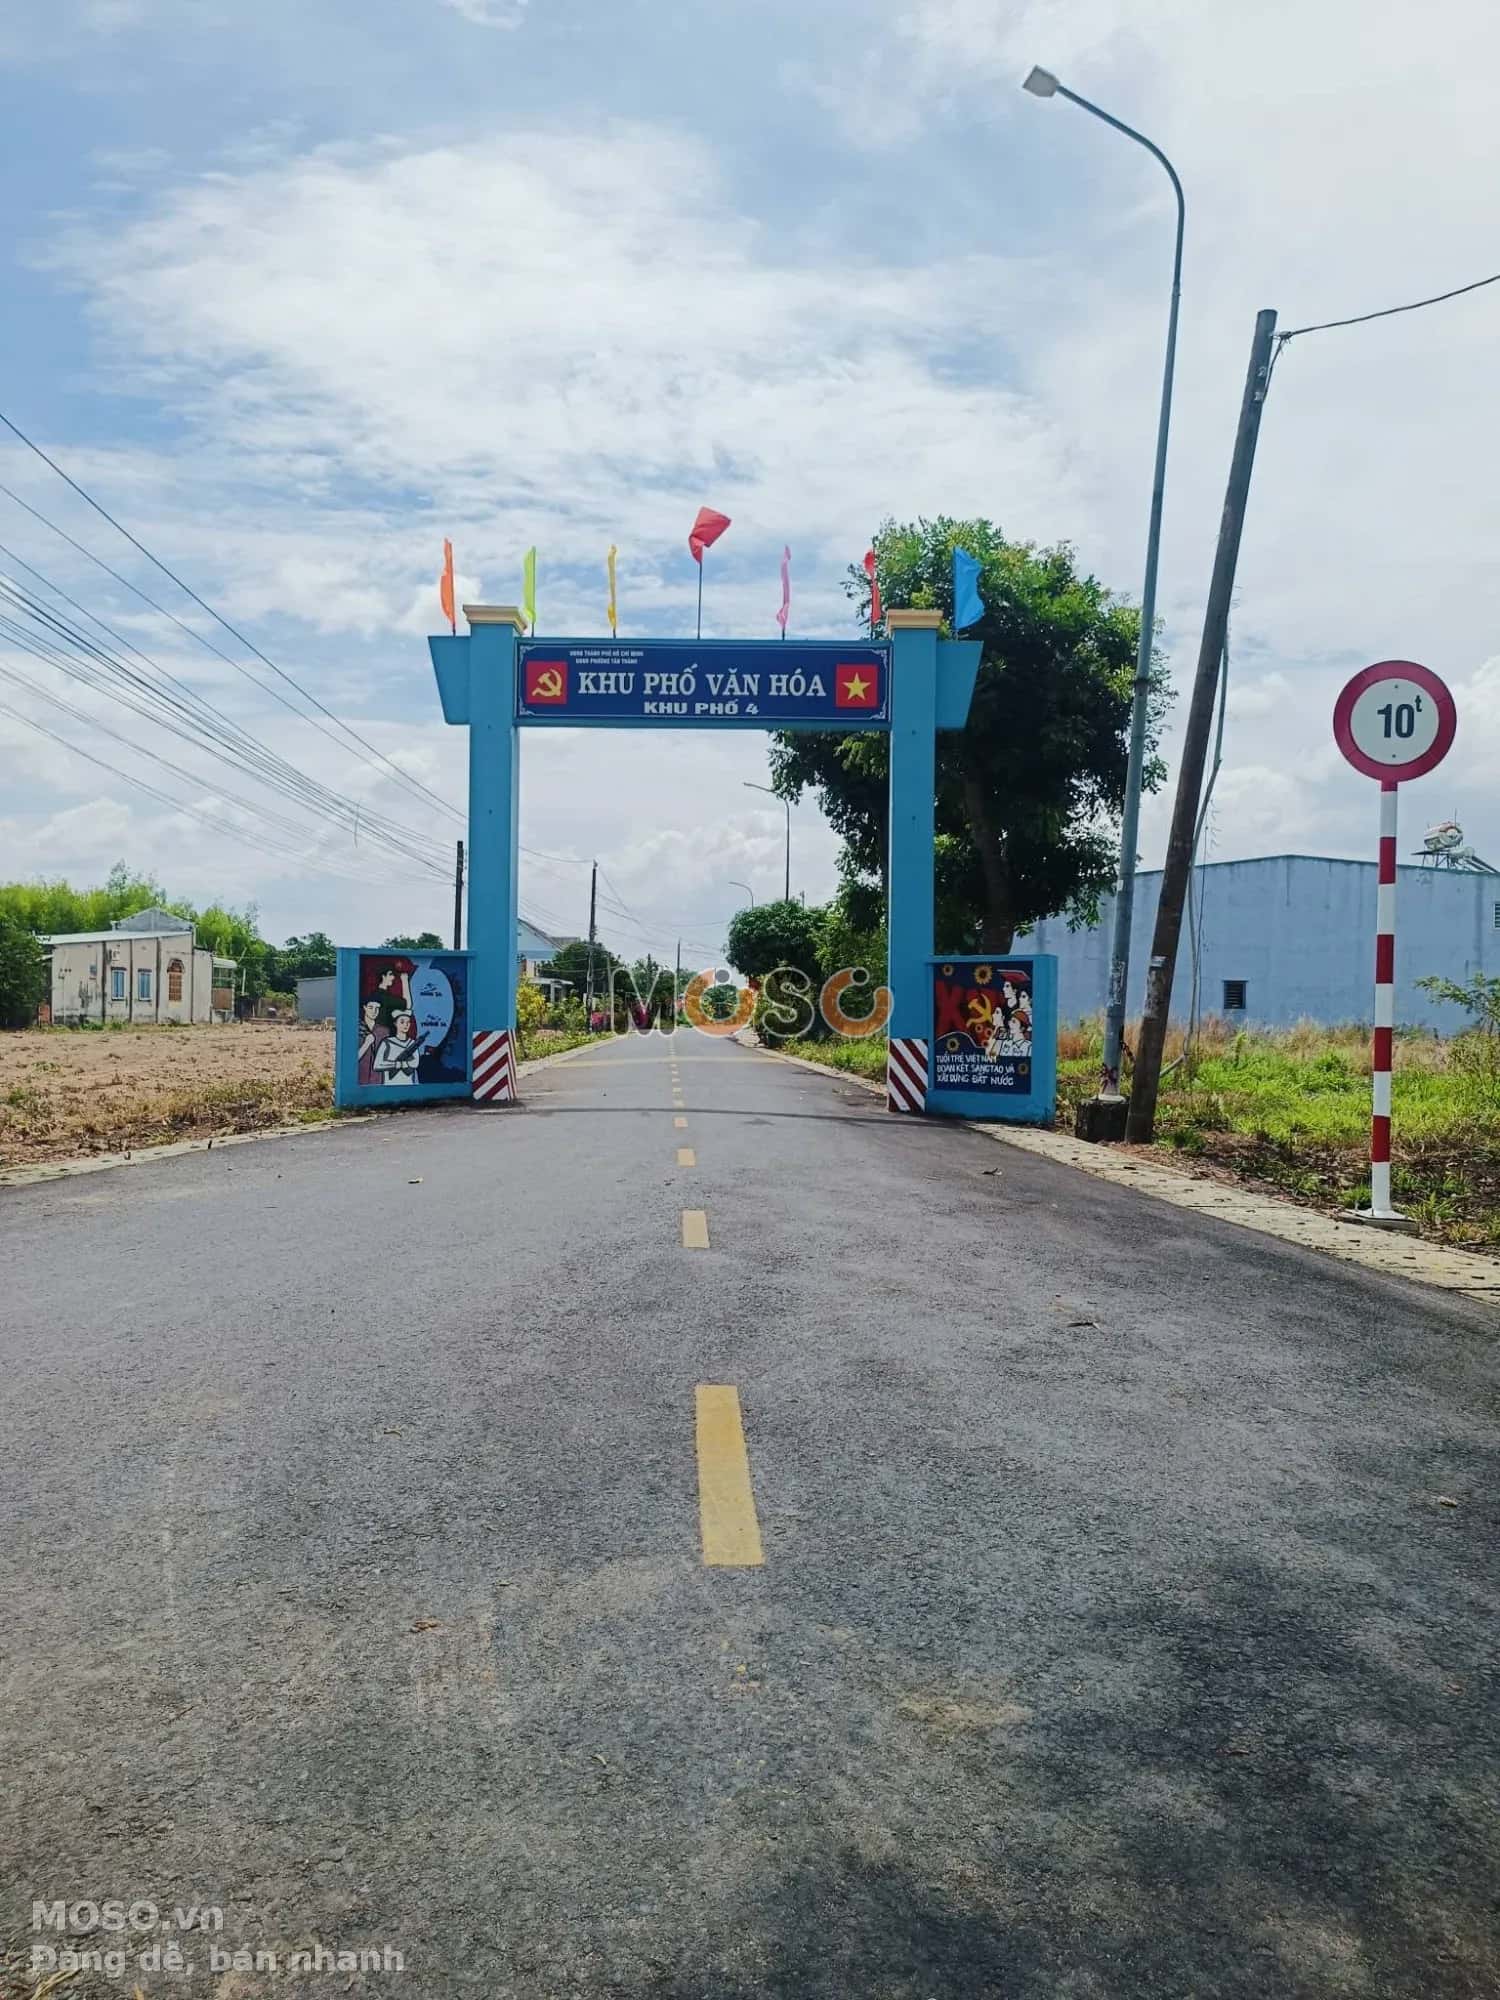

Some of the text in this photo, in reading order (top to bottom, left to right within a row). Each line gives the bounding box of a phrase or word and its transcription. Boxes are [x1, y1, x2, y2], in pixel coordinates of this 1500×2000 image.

[578, 664, 826, 697] KHU PHỐ VĂN HÓA
[644, 700, 759, 715] KHU PHỐ 4
